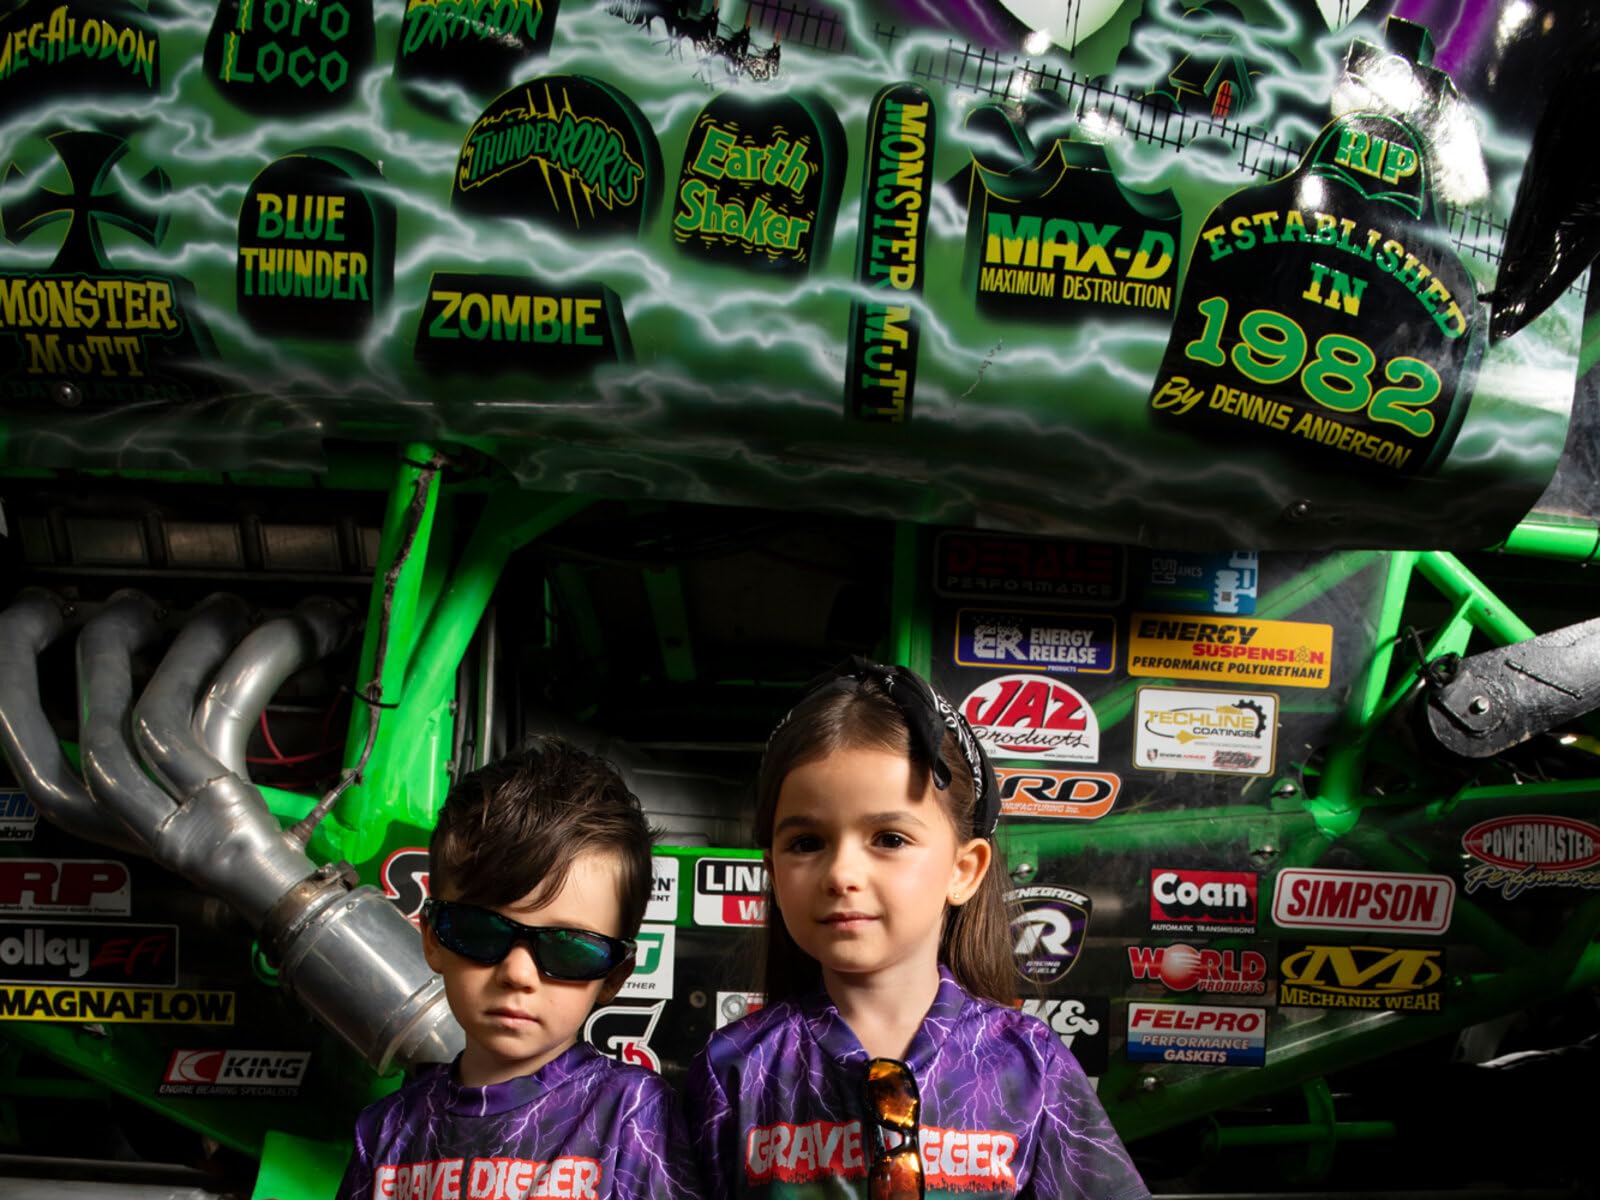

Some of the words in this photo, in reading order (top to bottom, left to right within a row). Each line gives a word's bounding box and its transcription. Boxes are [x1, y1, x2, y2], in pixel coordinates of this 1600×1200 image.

[402, 0, 544, 58] DRAGON
[691, 126, 810, 193] Earth
[1335, 126, 1418, 186] RIP
[675, 178, 810, 252] Shaker
[874, 100, 928, 290] MONSTER
[257, 193, 346, 242] BLUE
[986, 212, 1176, 280] MAX-D
[240, 247, 368, 300] THUNDER
[981, 267, 1056, 299] MAXIMUM
[1063, 275, 1171, 310] DESTRUCTION
[1203, 208, 1467, 340] ESTABLISHED
[1303, 261, 1369, 317] IN
[0, 279, 178, 331] MONSTER
[429, 291, 603, 346] ZOMBIE
[1185, 296, 1442, 437] 1982
[1152, 376, 1205, 415] By
[1209, 384, 1292, 432] DENNIS
[1293, 414, 1411, 468] ANDERSON
[1030, 628, 1095, 647] ENERGY
[1136, 620, 1258, 645] ENERGY
[1029, 645, 1097, 664] RELEASE
[1132, 656, 1223, 673] PERFORMANCE
[1227, 662, 1324, 680] POLYURETHANE
[966, 680, 1088, 731] JAZ
[1144, 709, 1256, 730] TECHLINE
[1192, 726, 1255, 738] COATINGS
[995, 774, 1113, 804] RD
[1481, 823, 1594, 864] POWERMASTER
[1153, 872, 1248, 908] Coan
[1287, 879, 1438, 922] SIMPSON
[1151, 923, 1194, 933] AUTOMATIC
[1197, 925, 1255, 935] TRANSMISSIONS
[0, 927, 91, 978] olley
[1128, 944, 1267, 991] WORLD
[0, 989, 231, 1021] MAGNAFLOW
[1197, 980, 1265, 994] PRODUCTS
[1281, 984, 1381, 1010] MECHANIX
[1385, 991, 1441, 1012] WEAR
[1131, 1008, 1260, 1033] FEL-PRO
[1141, 1035, 1250, 1051] PERFORMANCE
[1163, 1049, 1228, 1063] GASKETS
[223, 1057, 304, 1080] KING
[159, 1084, 195, 1095] ENGINE
[240, 1087, 300, 1097] SPECIALISTS
[748, 1121, 863, 1175] GRAVE
[886, 1128, 1016, 1178] GGER
